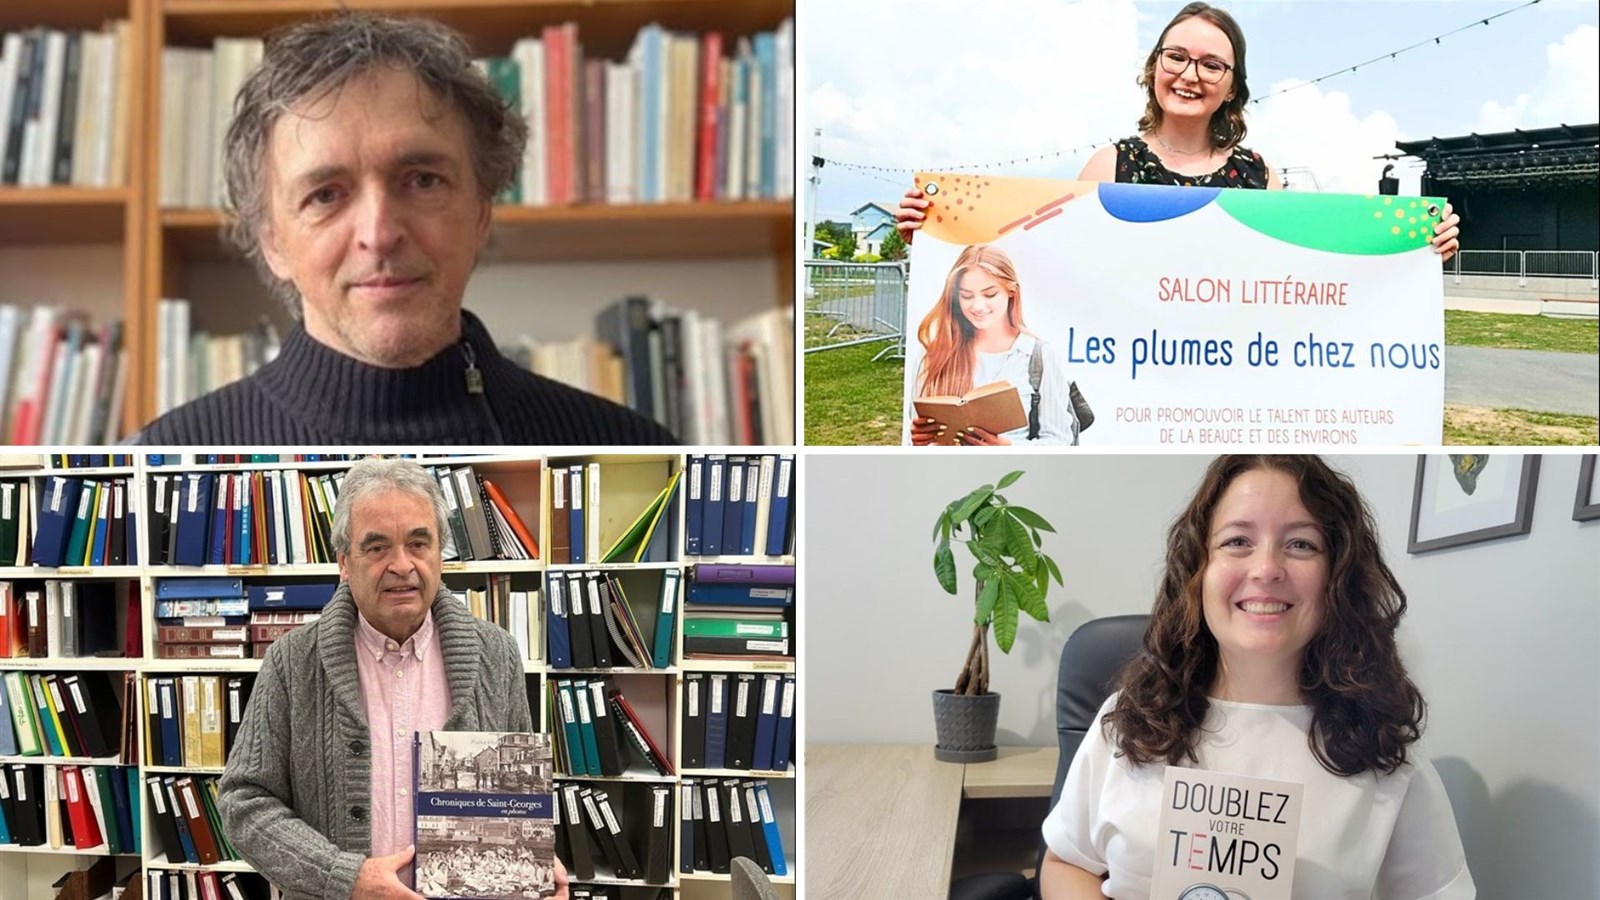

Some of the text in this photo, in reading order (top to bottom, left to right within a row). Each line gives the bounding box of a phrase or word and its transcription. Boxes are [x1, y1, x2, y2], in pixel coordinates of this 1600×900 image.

[1159, 275, 1348, 305] SALON LITTÉRAIRE
[1068, 327, 1440, 379] Les plumes de chez nous
[1116, 408, 1394, 424] POUR PROMOUVOIR LE TALENT DES AUTEURS
[1160, 428, 1357, 444] DE LA BEAUCE ET DES ENVIRONS
[431, 797, 542, 810] Chroniques de Saint-Georges
[1172, 781, 1290, 824] DOUBLEZ
[1209, 820, 1245, 835] VOTRE
[1170, 830, 1281, 880] TEMPS
